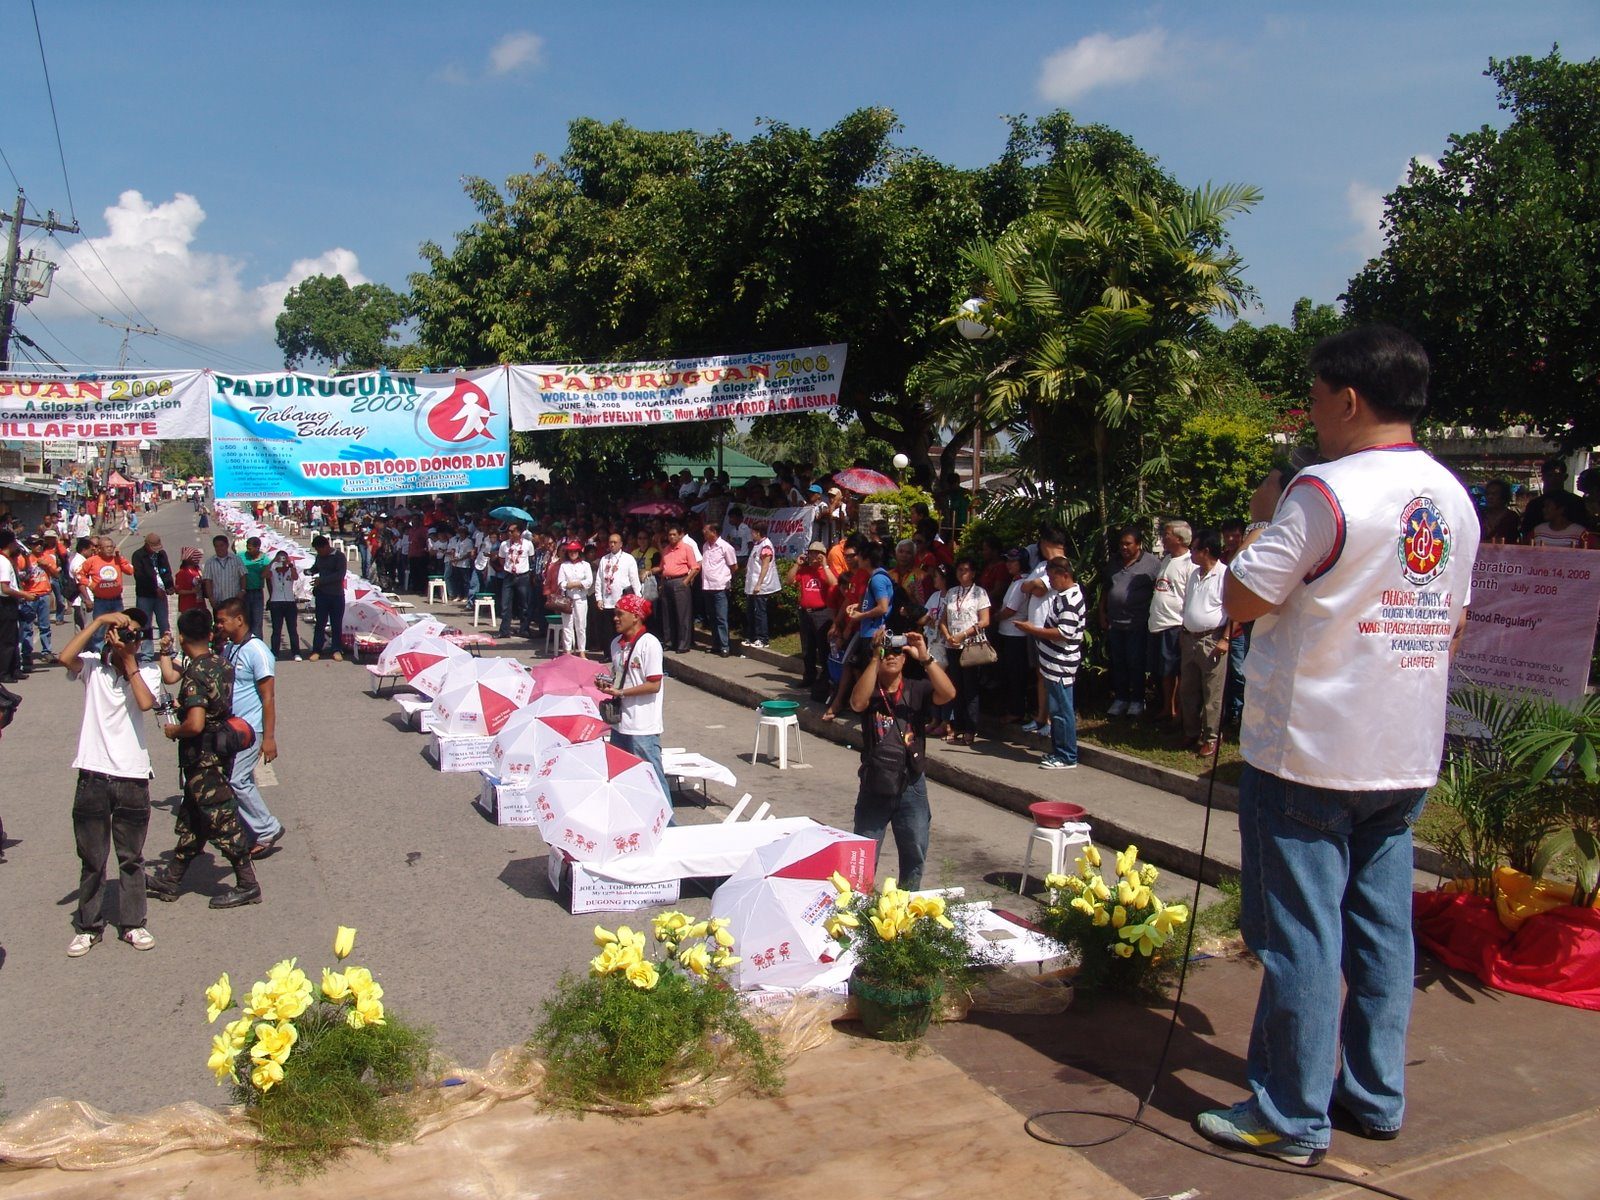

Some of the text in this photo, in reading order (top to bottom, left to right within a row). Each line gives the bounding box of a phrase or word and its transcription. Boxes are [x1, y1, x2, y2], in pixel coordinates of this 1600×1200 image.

[538, 355, 829, 391] PADURUGUAN 2008
[108, 379, 173, 402] 2008
[215, 374, 421, 397] PADURUGUAN
[711, 372, 834, 394] A Global Celebration
[351, 394, 421, 413] 2008
[541, 388, 685, 402] WORLD BLOOD DONOR DAY
[694, 394, 745, 403] CAMARINES
[771, 385, 815, 395] PHILIPPINES
[25, 399, 182, 412] A Global Celebration
[250, 405, 332, 424] Tabang
[573, 413, 602, 426] Mayor
[603, 411, 642, 423] EVELYN
[780, 393, 838, 411] CALISURA
[1, 412, 156, 420] CAMARINES SUR PHILIPPINES
[297, 421, 369, 440] Buhay
[302, 453, 506, 477] WORLD BLOOD DONOR DAY
[1528, 567, 1549, 578] June
[1568, 569, 1590, 580] 2008
[1512, 583, 1529, 594] July
[1534, 584, 1557, 596] 2008
[1466, 611, 1491, 624] Blood
[1400, 657, 1434, 669] CHAPTER
